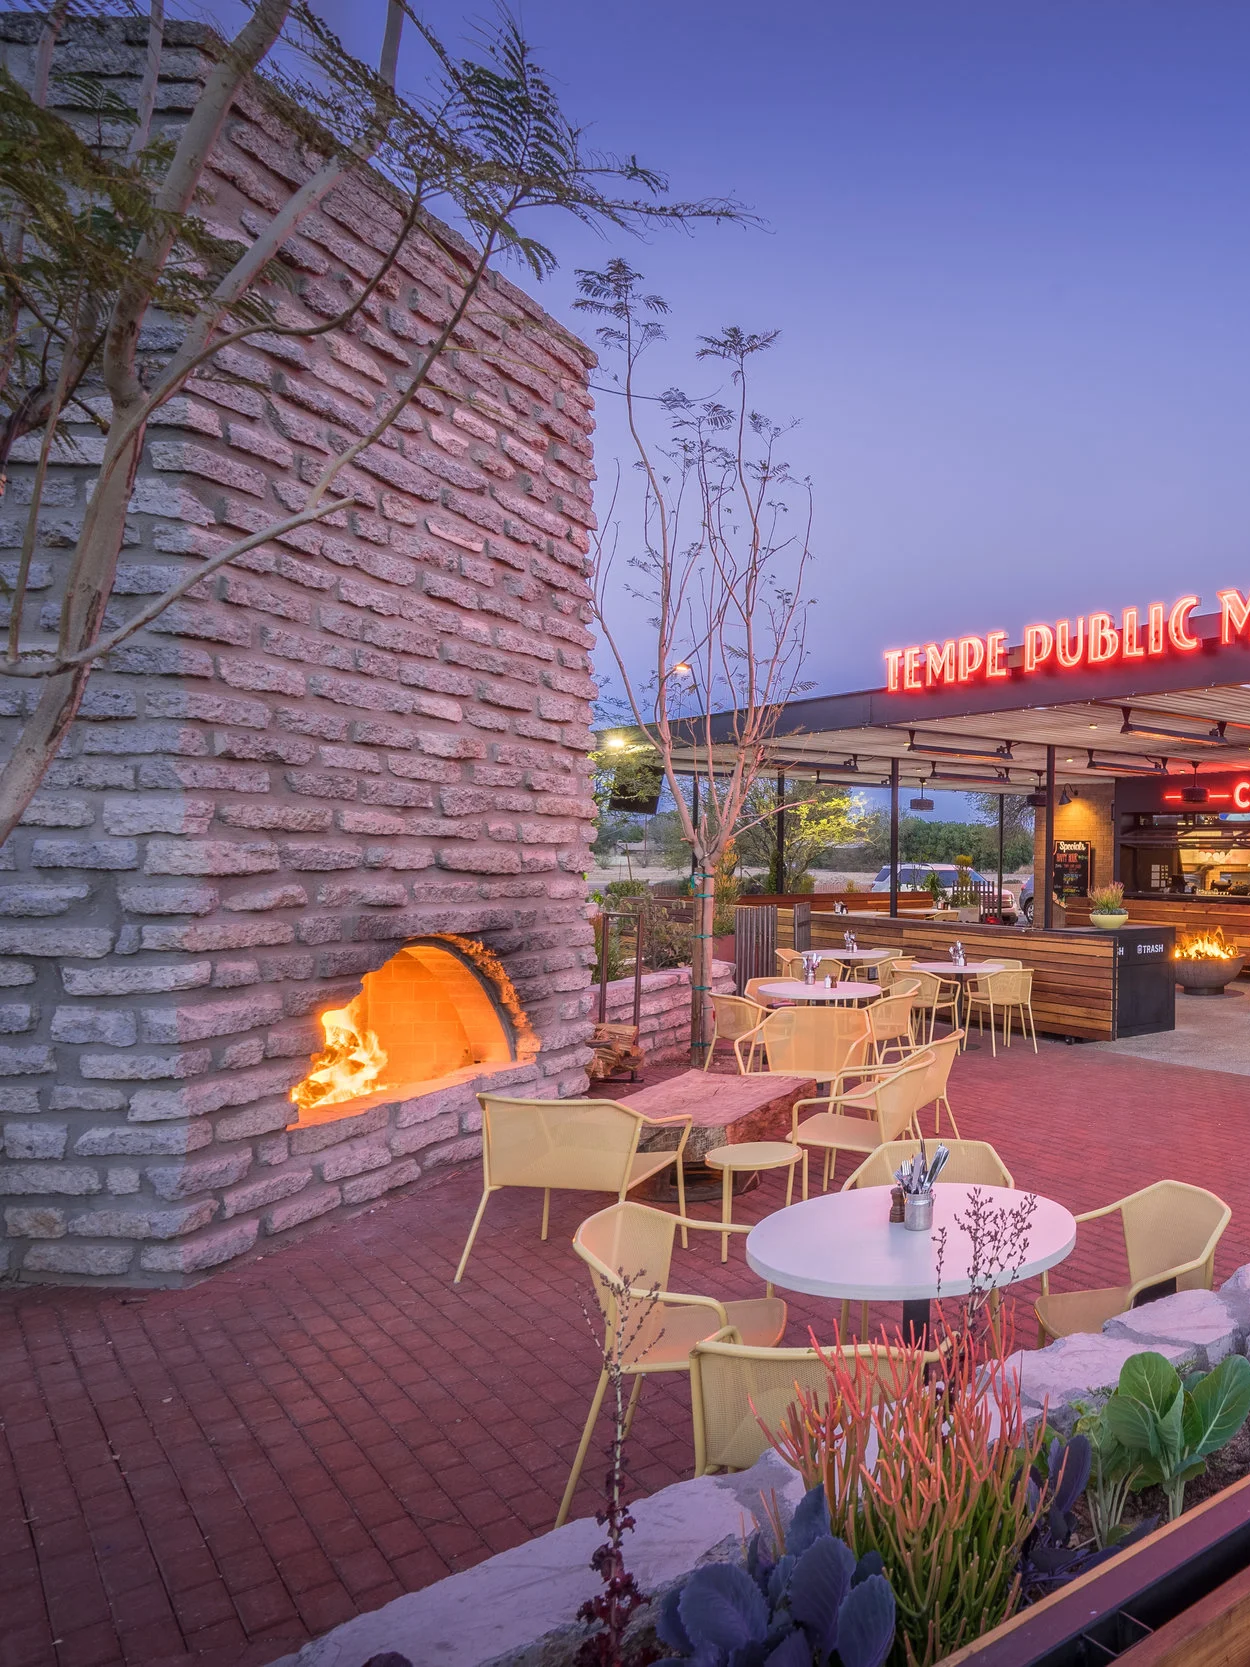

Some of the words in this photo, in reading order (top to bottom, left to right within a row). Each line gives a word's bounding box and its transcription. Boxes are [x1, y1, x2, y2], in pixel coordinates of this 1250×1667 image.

[884, 629, 1008, 692] TEMPE
[1023, 594, 1202, 673] PUBLIC
[1142, 943, 1164, 954] TRASH
